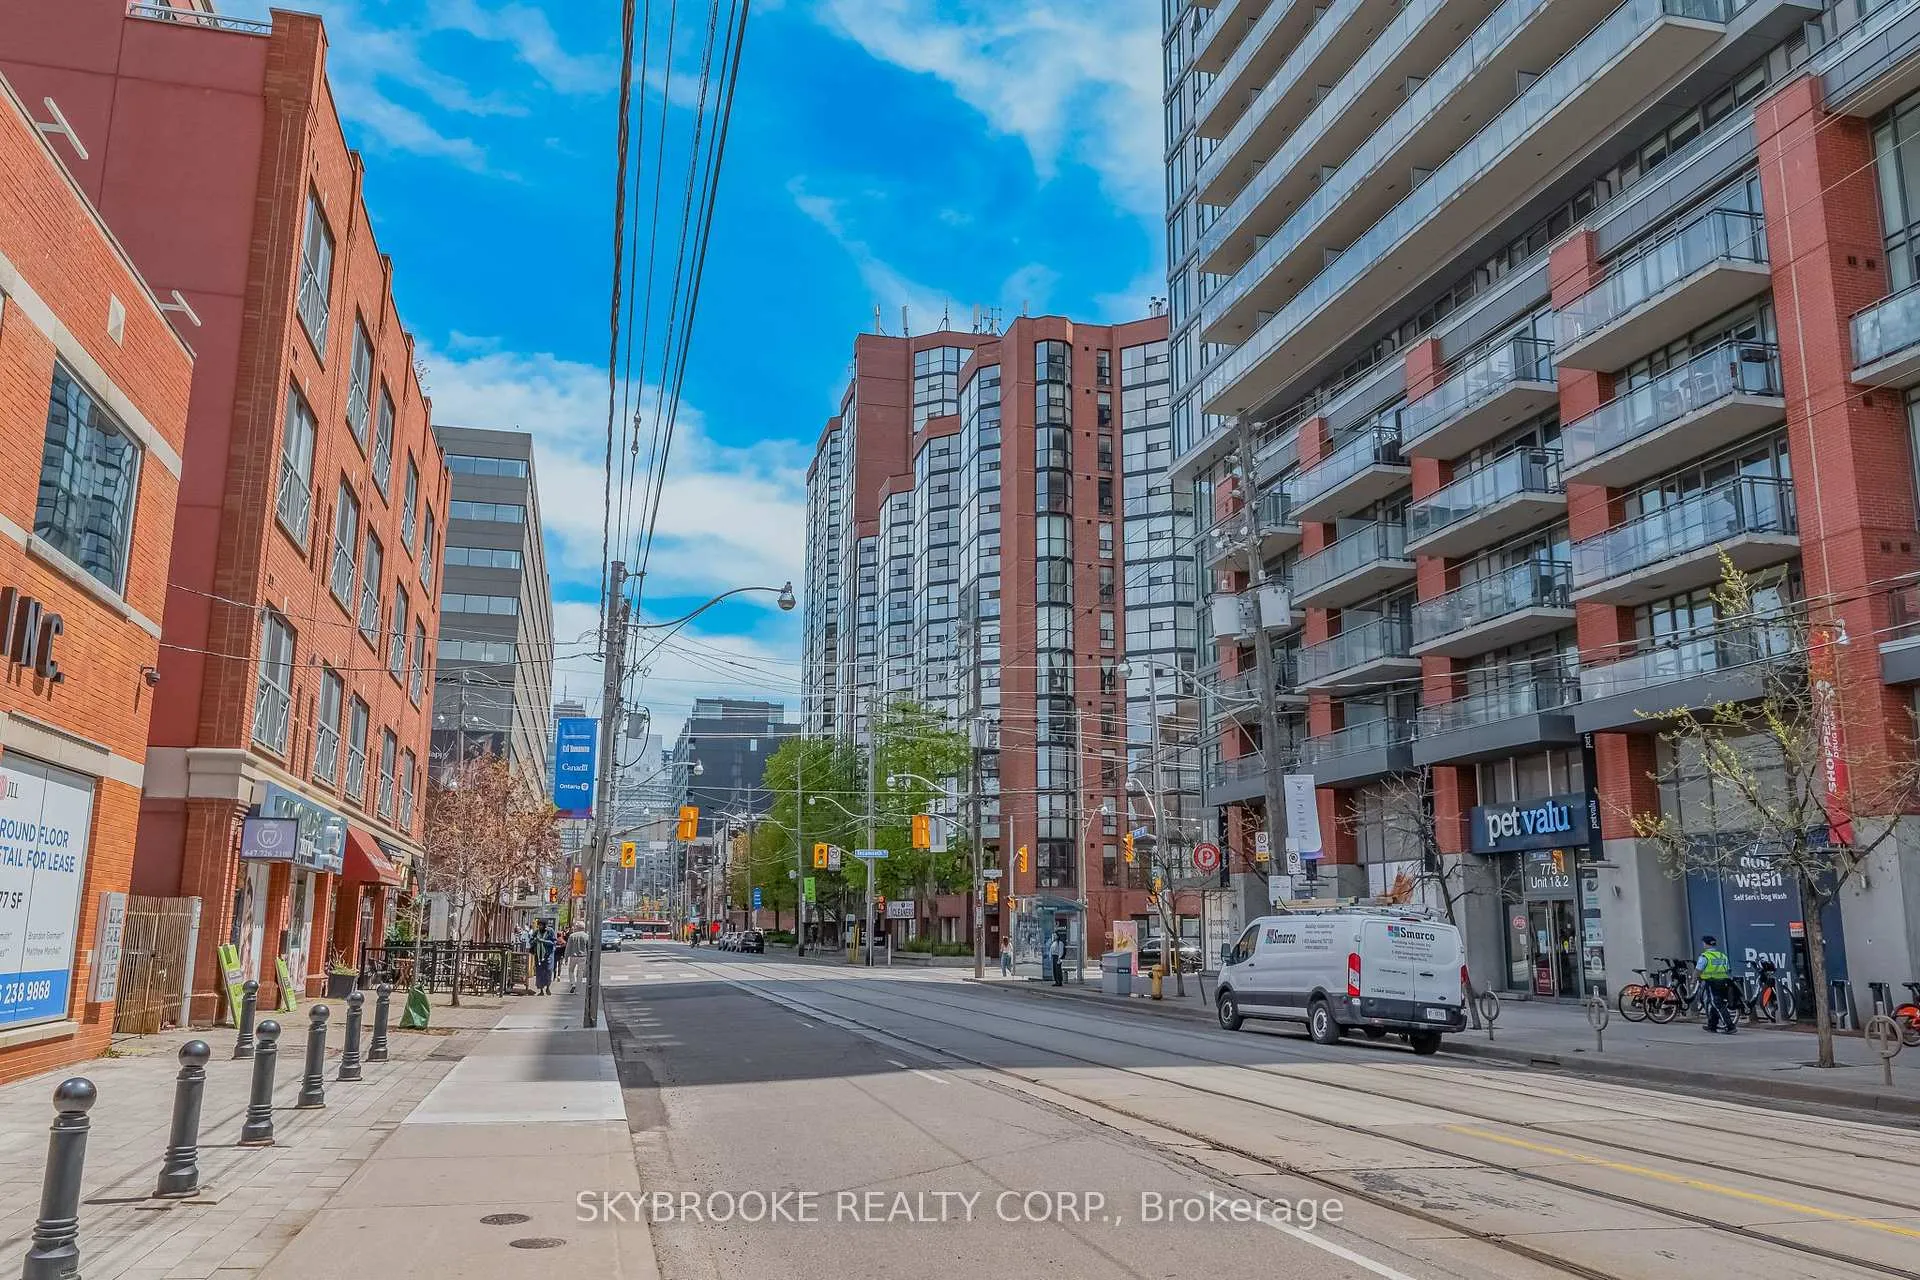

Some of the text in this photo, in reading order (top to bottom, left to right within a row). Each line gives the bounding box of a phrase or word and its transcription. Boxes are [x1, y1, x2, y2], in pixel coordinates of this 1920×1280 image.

[0, 586, 64, 684] INC.
[562, 763, 588, 771] Canada
[1487, 800, 1570, 846] pet valu
[39, 826, 69, 848] FLOOR
[26, 850, 47, 869] FOR
[48, 853, 75, 873] LEASE
[1541, 863, 1557, 876] 775
[1531, 877, 1548, 889] Unit
[1555, 876, 1562, 887] &
[1563, 875, 1569, 887] 2
[1735, 870, 1782, 888] wash
[11, 892, 23, 909] SF
[1761, 893, 1772, 902] Dog
[1772, 892, 1787, 900] Wash
[1272, 929, 1296, 945] Smarco
[1400, 927, 1435, 941] Smarco
[4, 980, 51, 1004] 238 9868
